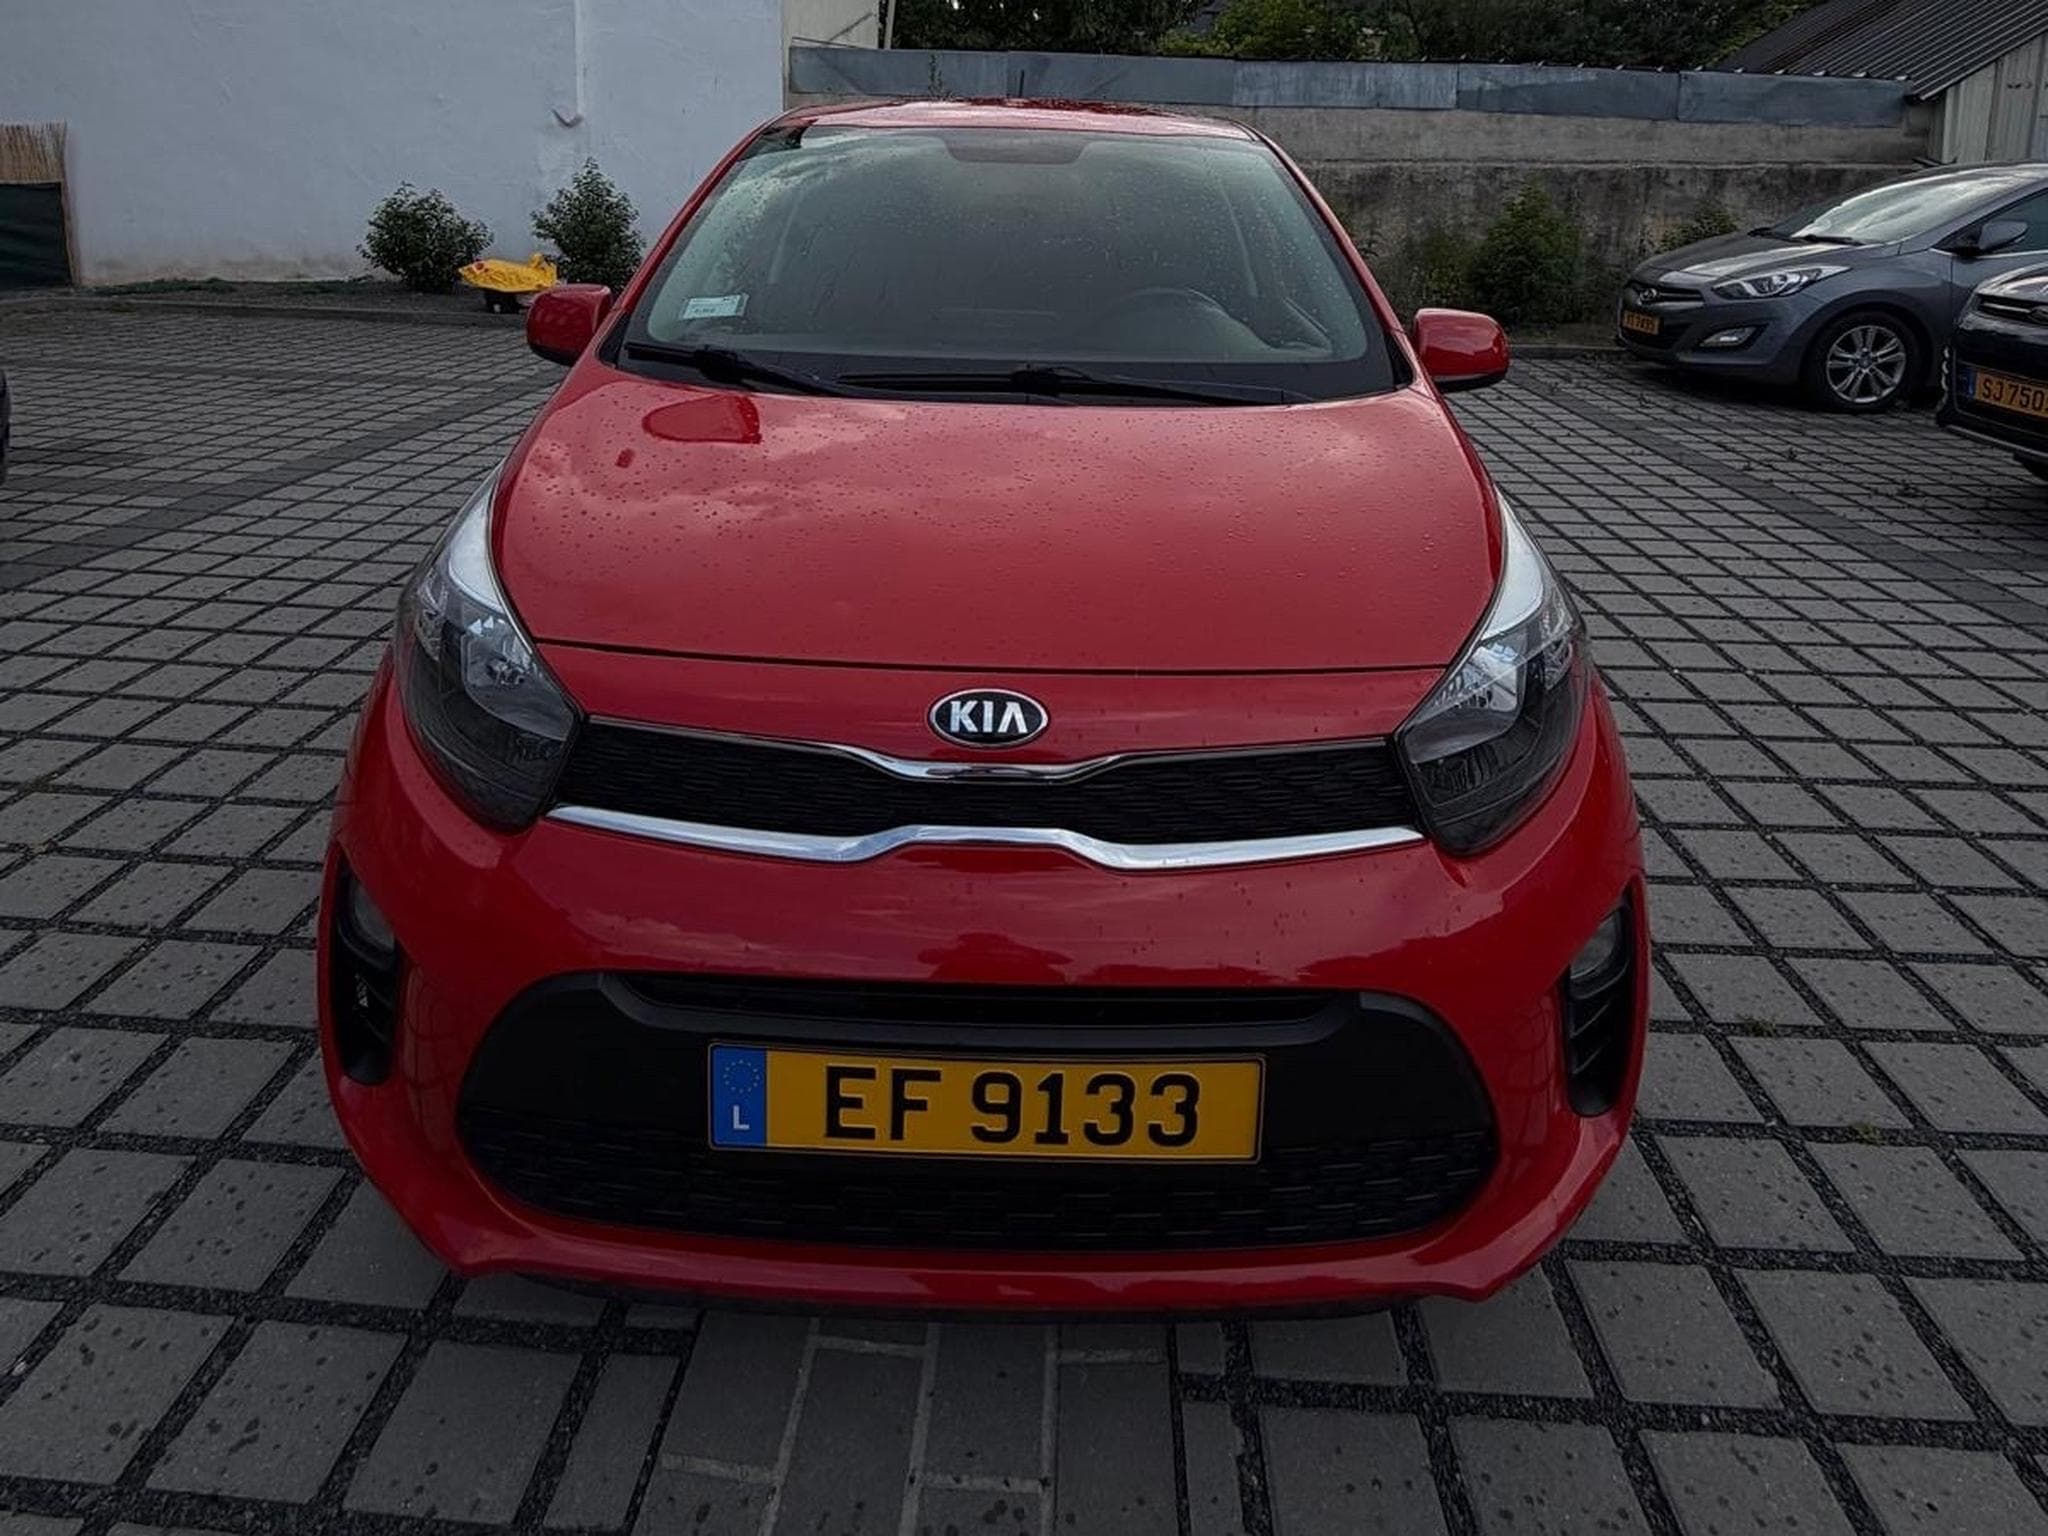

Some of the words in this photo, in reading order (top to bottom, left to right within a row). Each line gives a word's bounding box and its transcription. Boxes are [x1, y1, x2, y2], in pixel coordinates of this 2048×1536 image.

[1982, 377, 2004, 401] SJ
[2008, 383, 2048, 412] 750
[949, 700, 1029, 734] KIA
[733, 1104, 750, 1130] L
[824, 1064, 942, 1142] EF
[970, 1070, 1201, 1148] 9133
